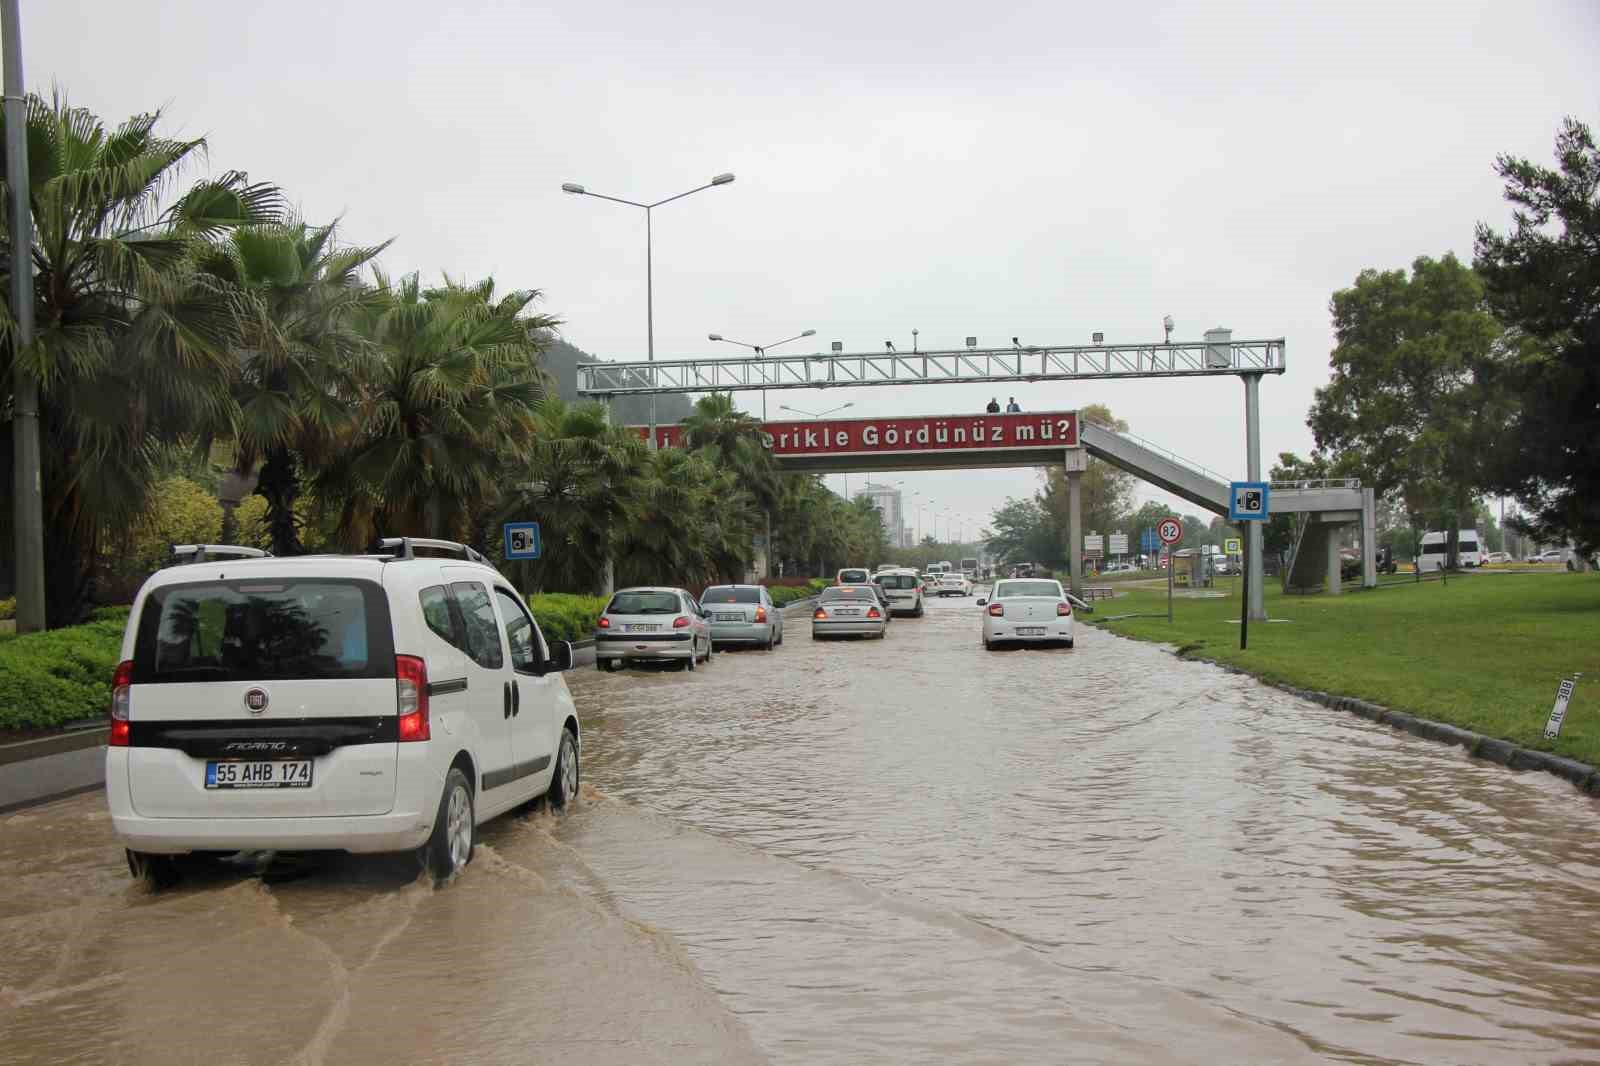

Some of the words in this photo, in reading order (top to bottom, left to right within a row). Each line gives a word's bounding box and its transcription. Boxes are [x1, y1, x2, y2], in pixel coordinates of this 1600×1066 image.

[862, 420, 1003, 446] Gördünüz
[1015, 419, 1070, 441] mü?
[1162, 526, 1176, 537] 82
[217, 764, 237, 782] 55
[242, 763, 273, 782] AHB
[281, 762, 308, 781] 174
